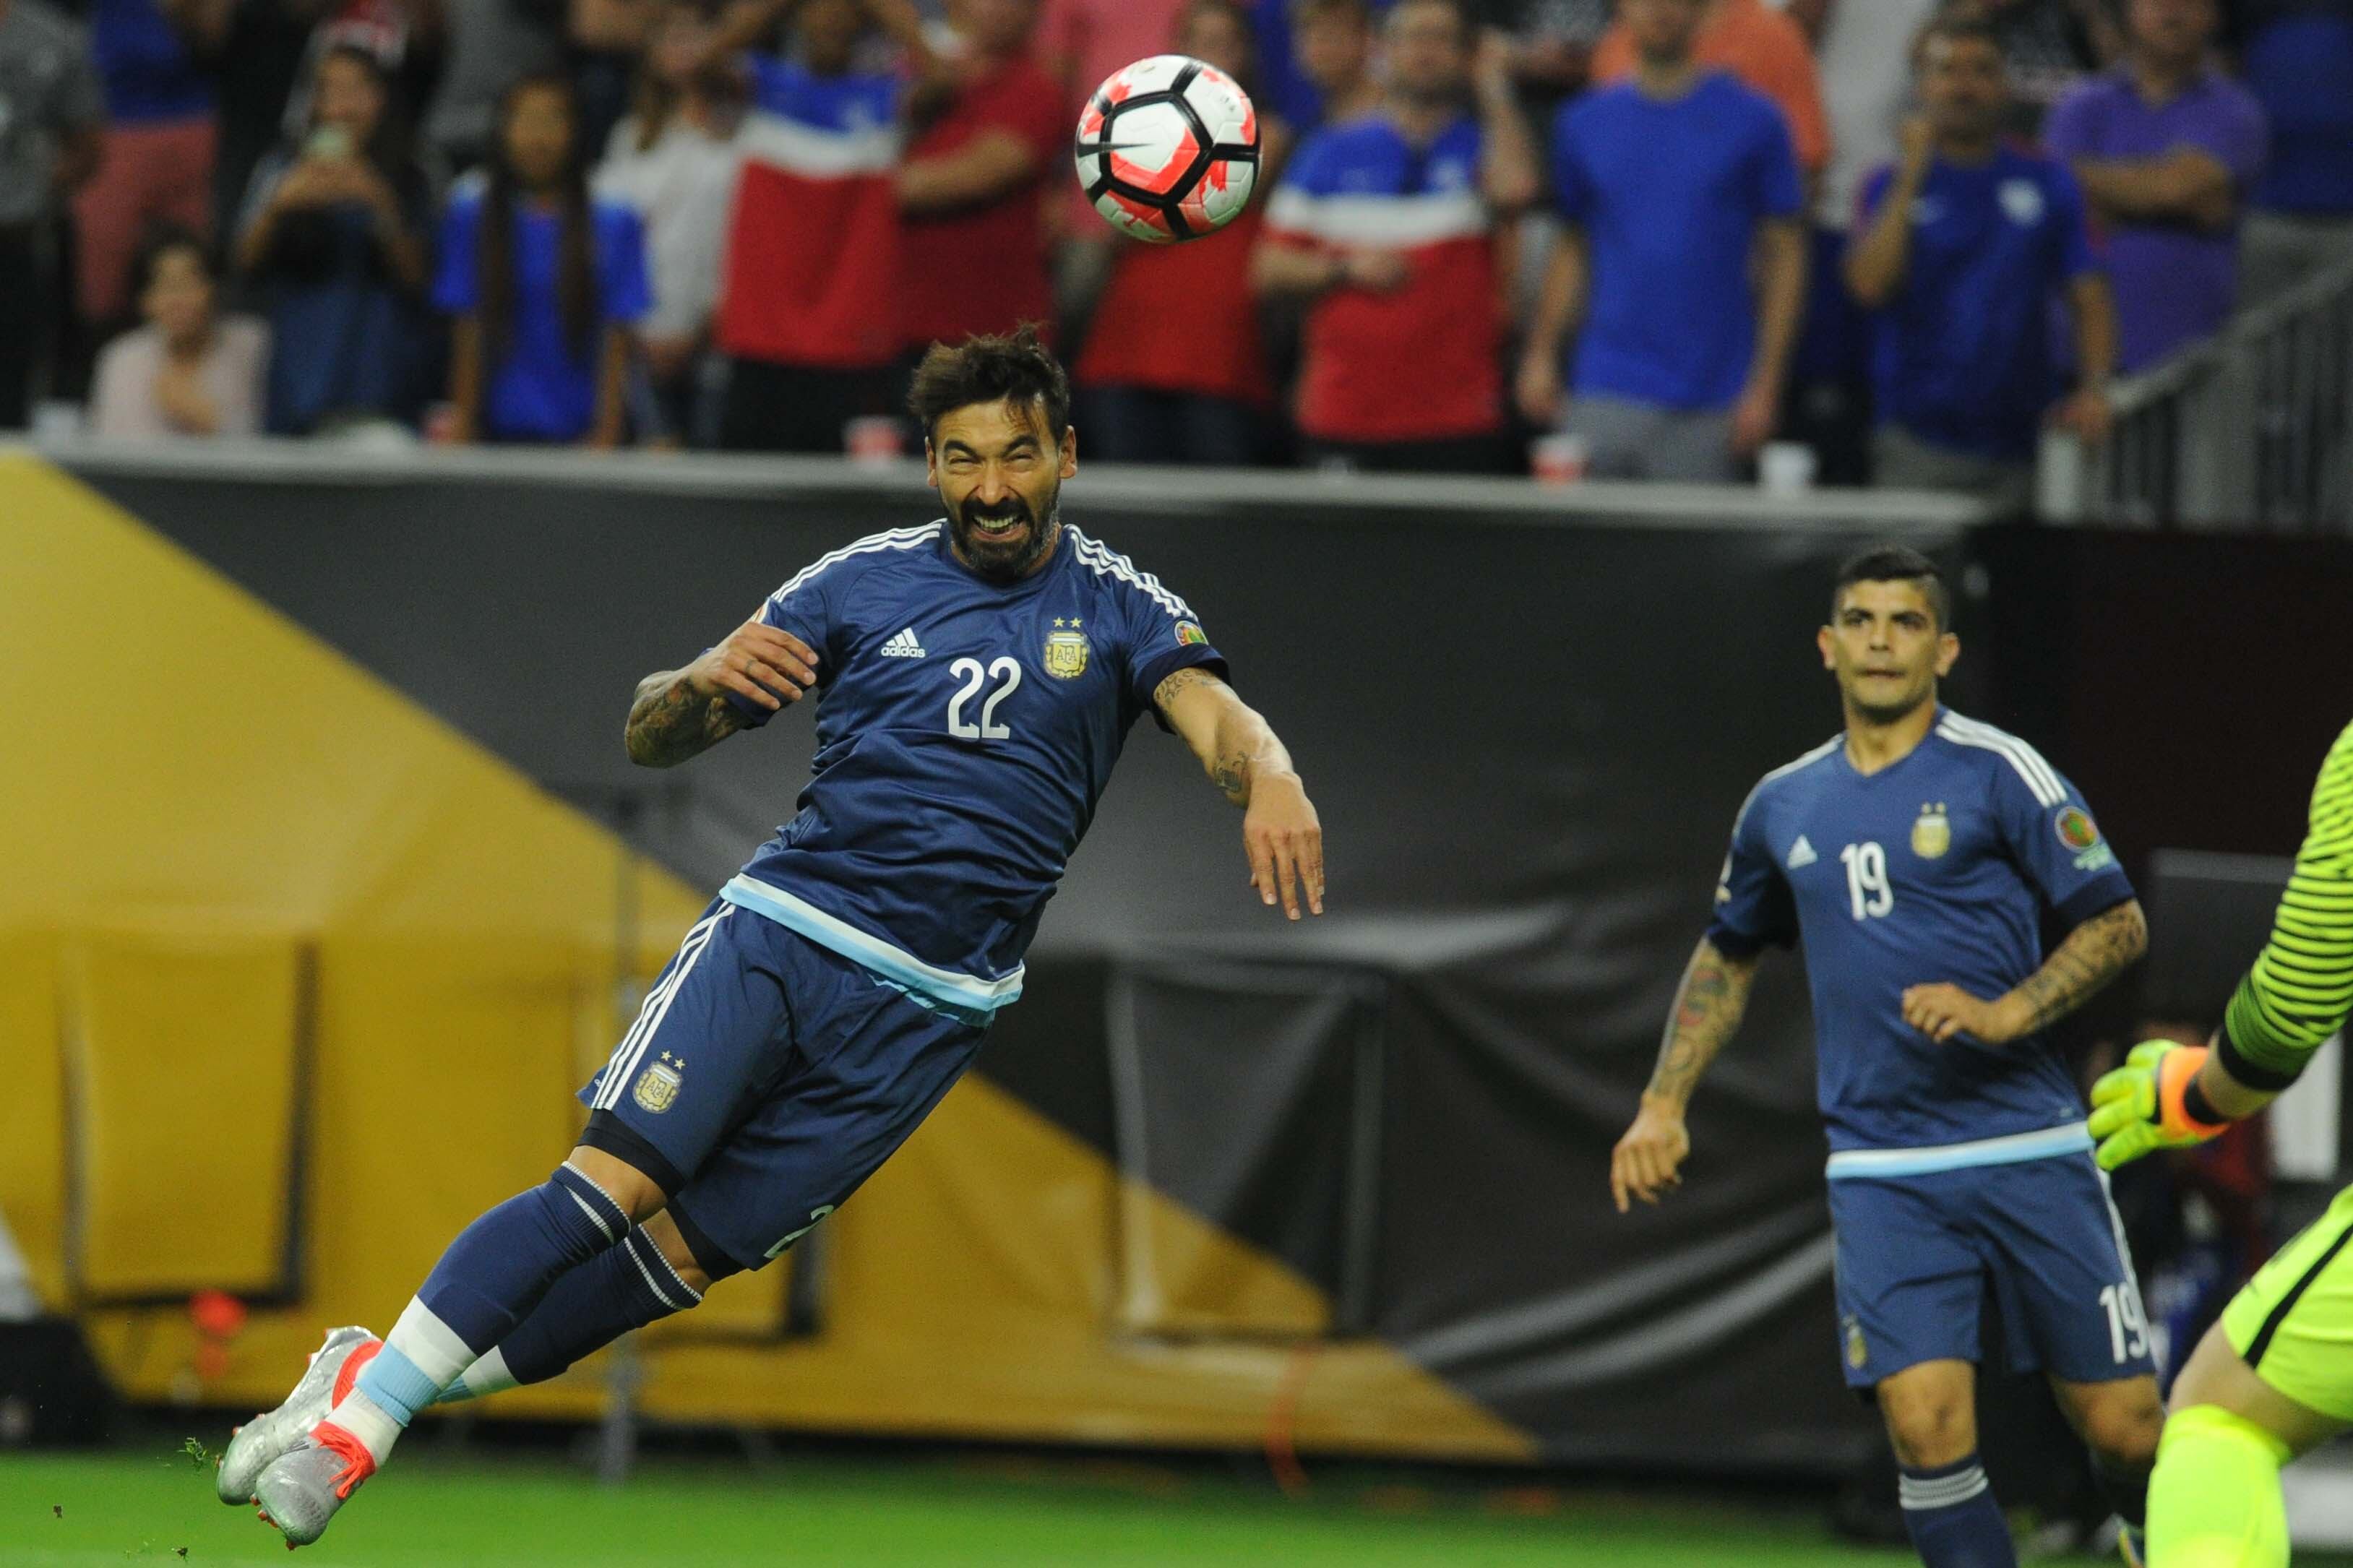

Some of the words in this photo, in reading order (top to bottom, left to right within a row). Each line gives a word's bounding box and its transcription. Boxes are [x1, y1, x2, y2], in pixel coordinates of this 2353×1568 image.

[881, 645, 926, 658] adidas
[947, 656, 1022, 739] 22
[1839, 841, 1894, 921] 19
[2099, 1281, 2149, 1364] 19
